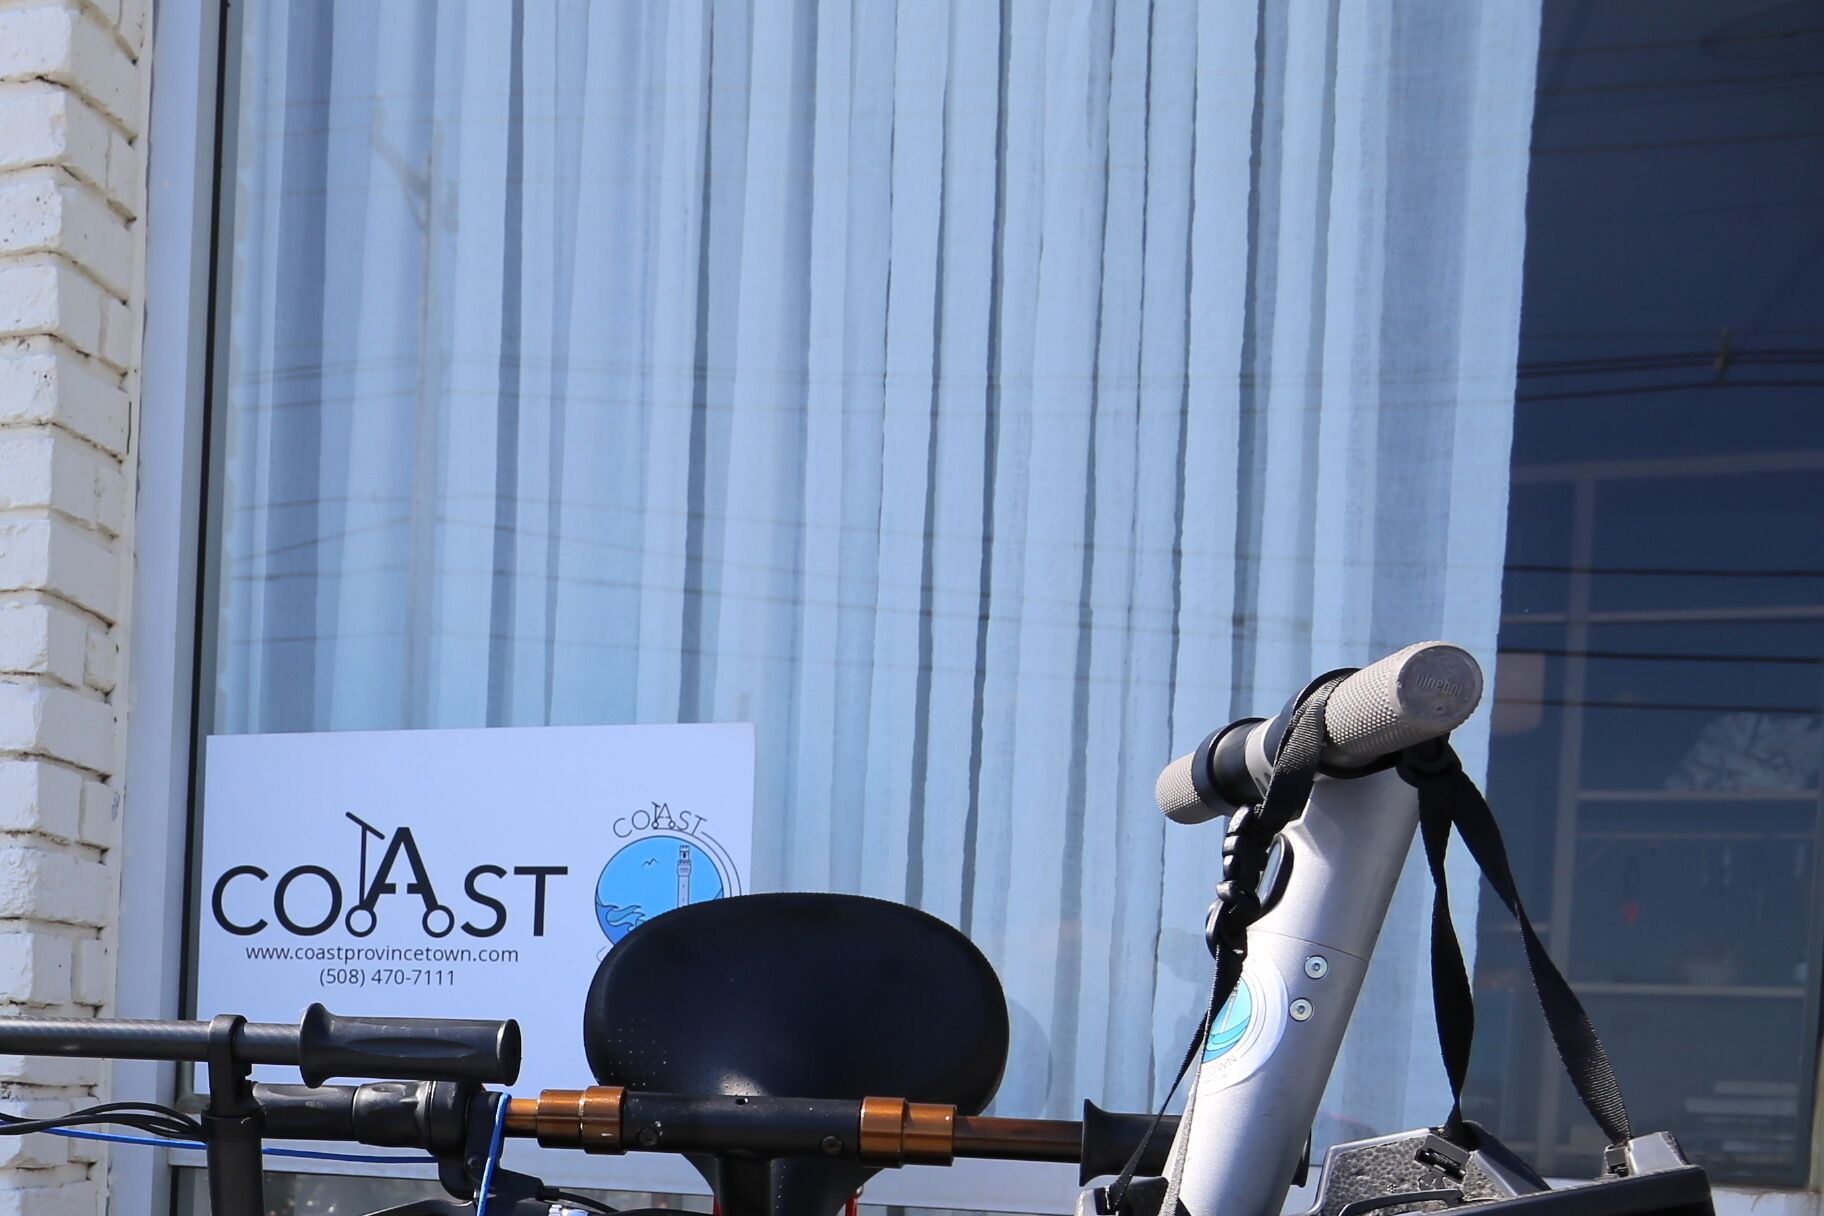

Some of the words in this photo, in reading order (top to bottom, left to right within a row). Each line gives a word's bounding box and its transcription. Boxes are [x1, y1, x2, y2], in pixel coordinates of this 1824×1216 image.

[613, 801, 708, 838] COAST
[211, 812, 568, 938] COAST
[245, 943, 519, 963] www.coastprovincetown.com
[319, 968, 366, 987] (508)
[370, 968, 456, 987] 470-7111
